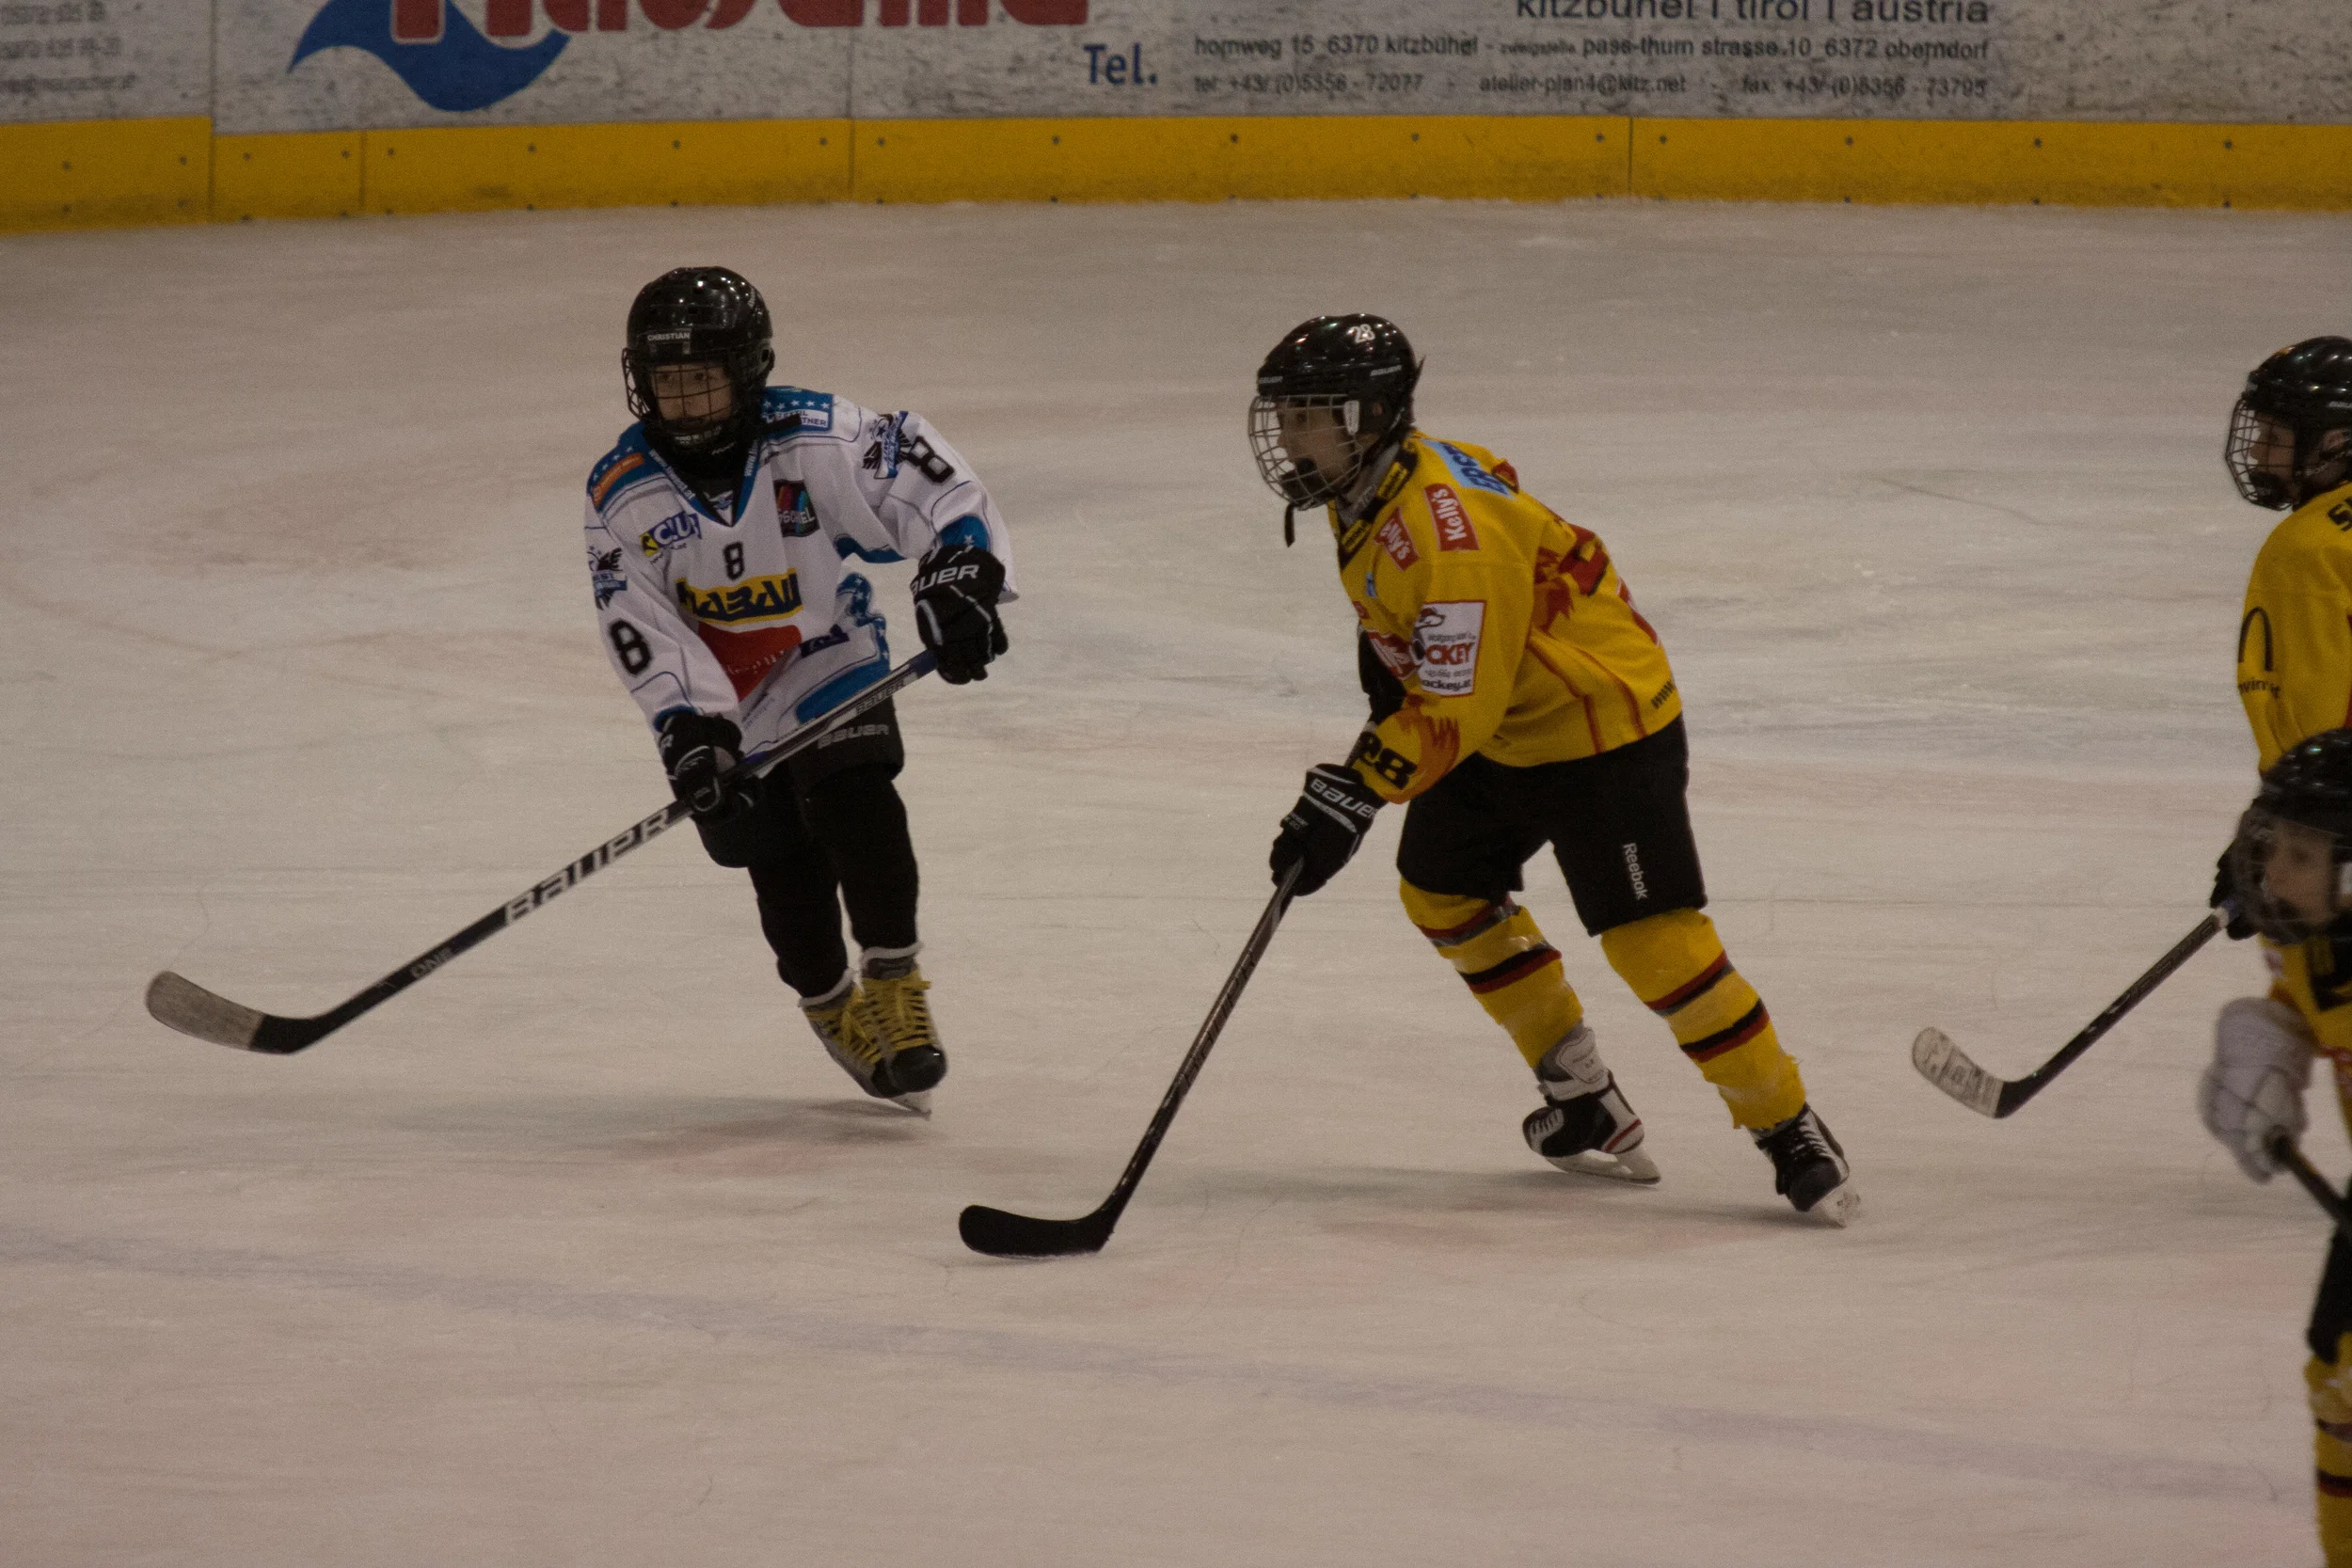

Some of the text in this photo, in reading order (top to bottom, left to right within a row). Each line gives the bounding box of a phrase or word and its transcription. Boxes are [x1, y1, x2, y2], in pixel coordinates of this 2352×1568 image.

[1851, 0, 1989, 23] austria
[1084, 42, 1157, 86] Tel.
[646, 331, 691, 343] CHRISTIAN
[1346, 324, 1375, 343] 28
[908, 435, 955, 484] 8
[1430, 488, 1468, 542] Kelly's
[722, 541, 746, 581] 8
[910, 564, 980, 596] AUER
[607, 618, 654, 676] 8
[503, 807, 670, 926] BAUER
[1622, 842, 1648, 900] Reebok
